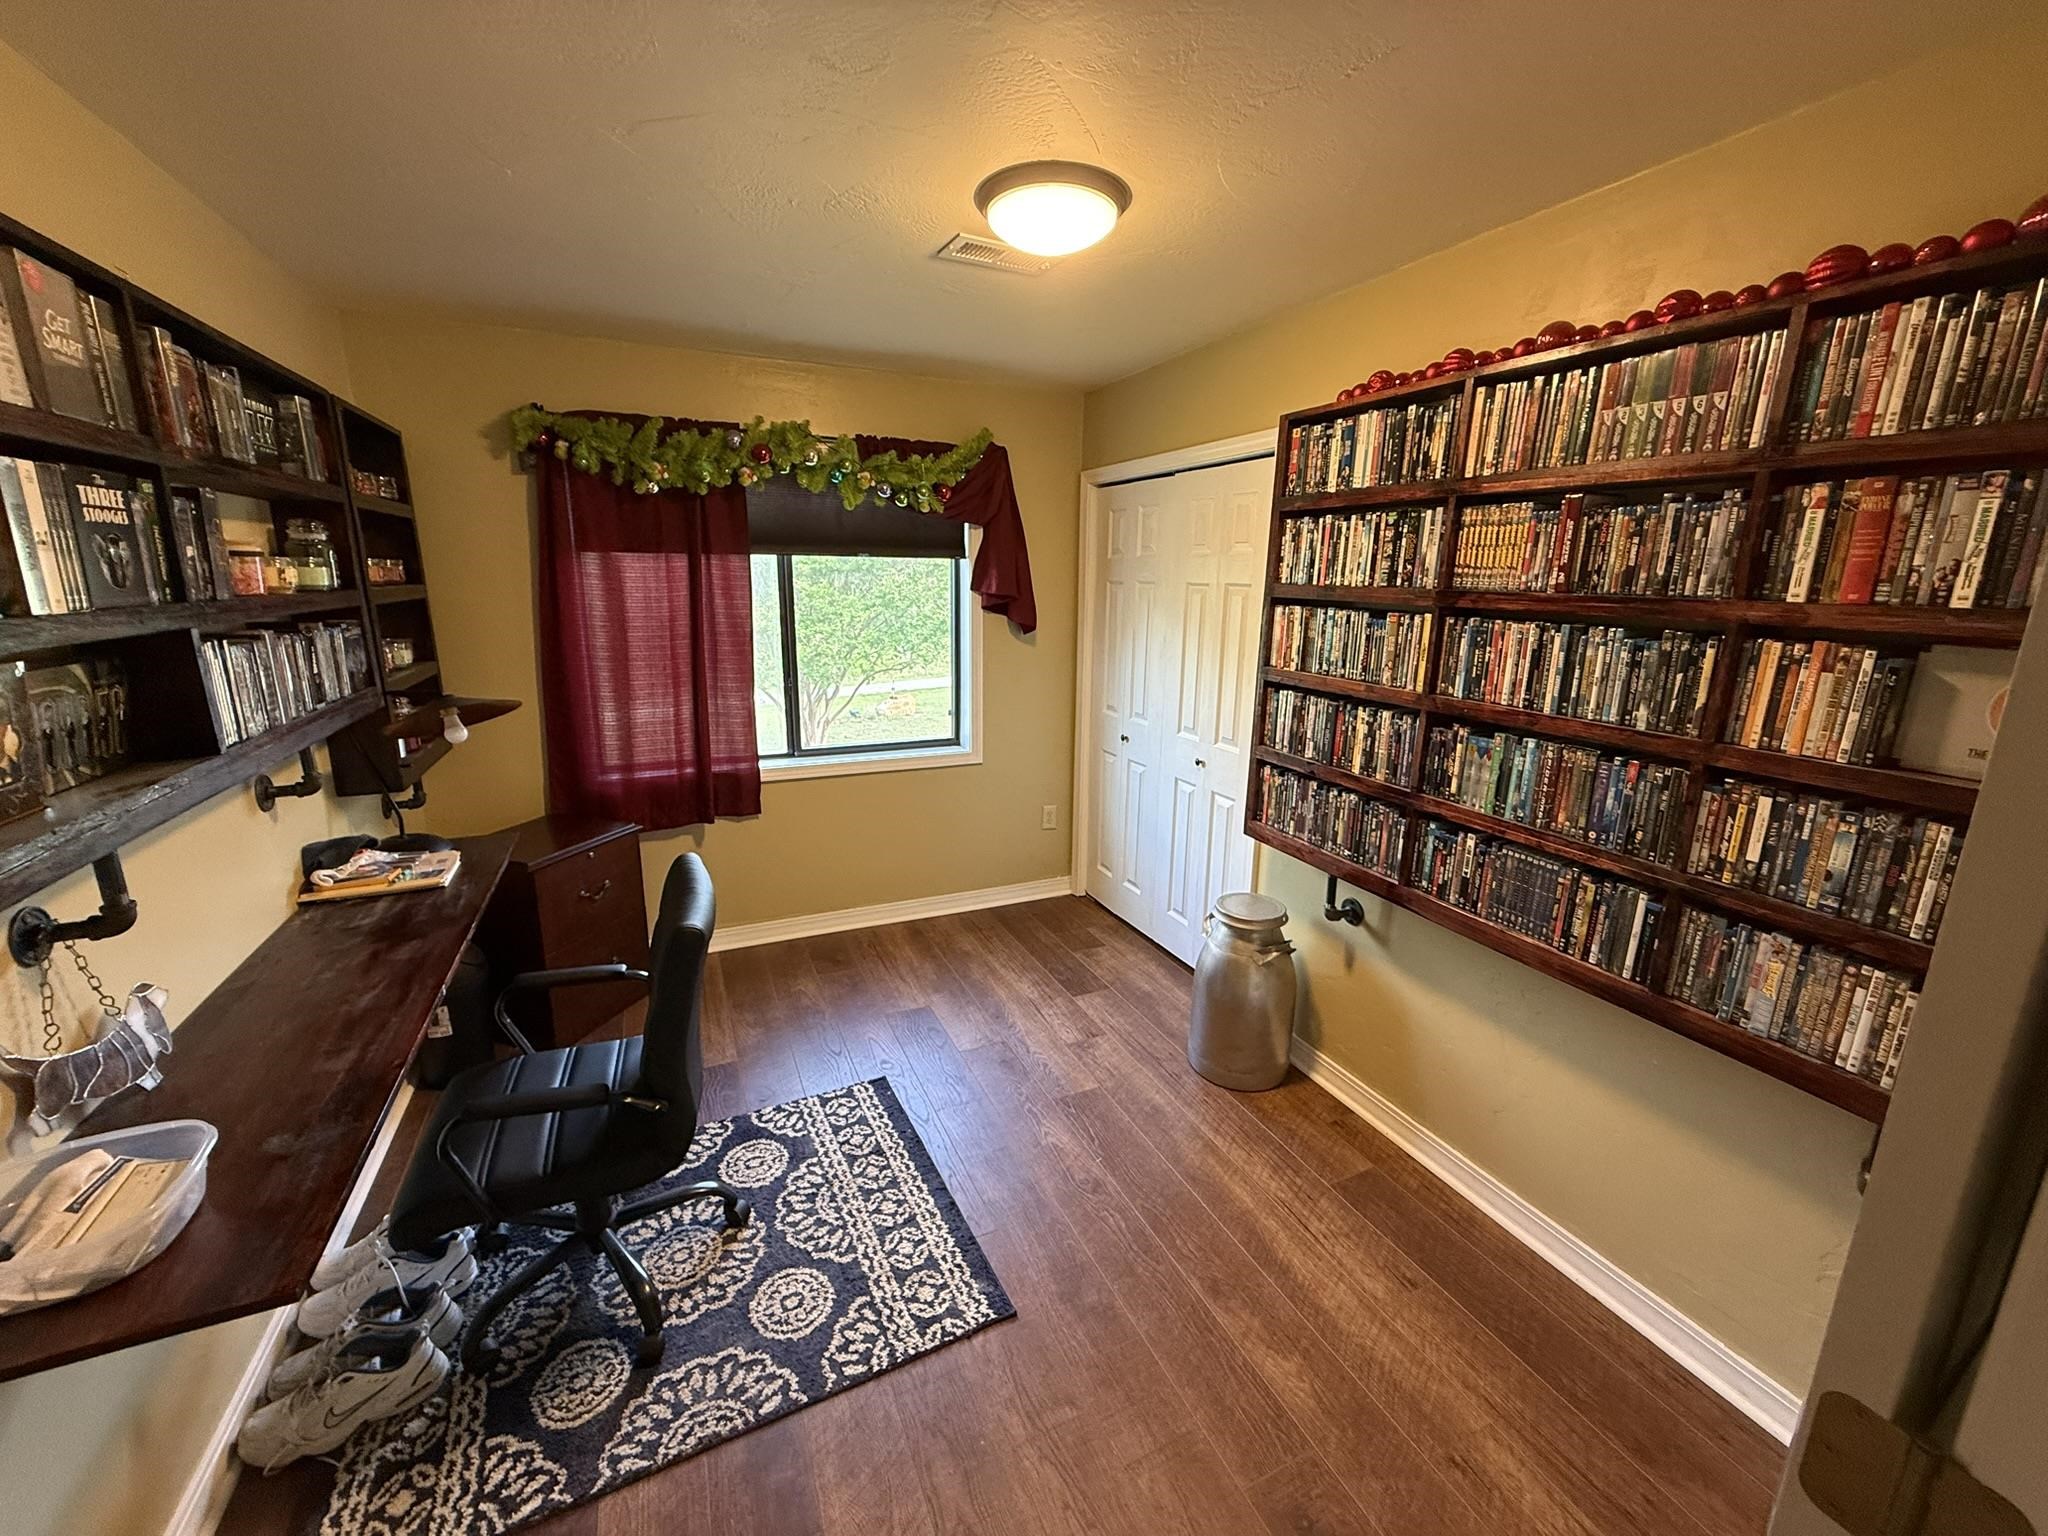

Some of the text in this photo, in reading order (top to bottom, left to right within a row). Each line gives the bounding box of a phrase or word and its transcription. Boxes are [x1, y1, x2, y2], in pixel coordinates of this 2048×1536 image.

[45, 309, 70, 334] GET
[42, 326, 83, 361] SMART
[1866, 356, 1886, 381] FLINT
[91, 474, 105, 485] The
[76, 485, 126, 509] THREE
[83, 508, 129, 525] STOOGES
[1974, 507, 1991, 541] MARRIED
[1599, 518, 1608, 544] TAKEN
[1803, 516, 1816, 546] MARRIED
[1968, 748, 1990, 760] THE
[1691, 930, 1703, 958] TARZAN
